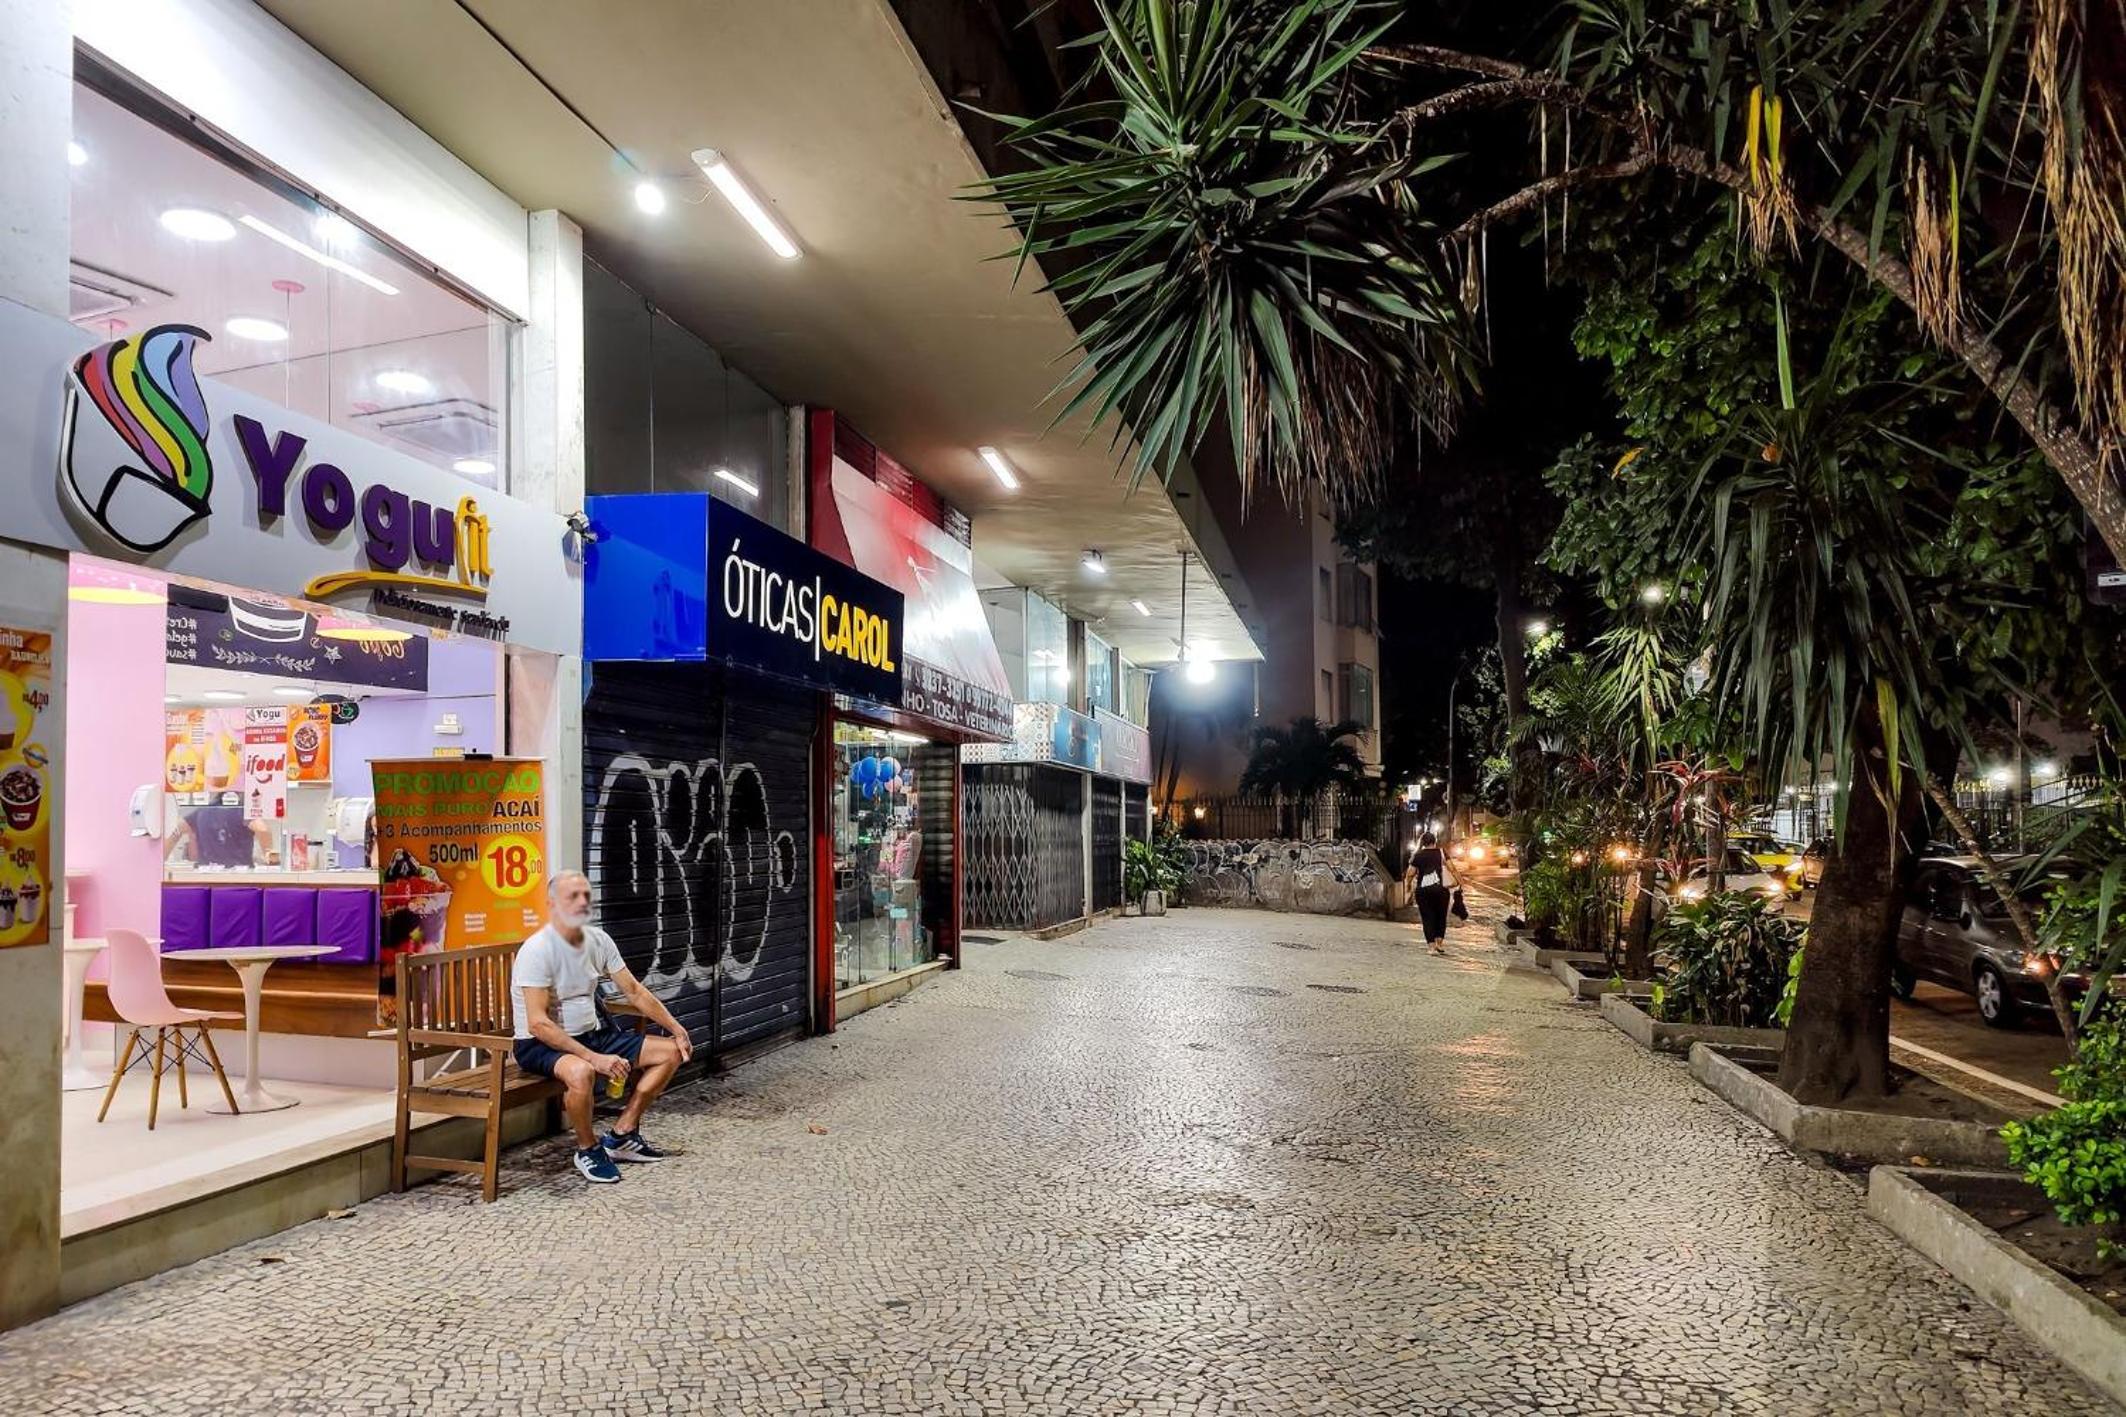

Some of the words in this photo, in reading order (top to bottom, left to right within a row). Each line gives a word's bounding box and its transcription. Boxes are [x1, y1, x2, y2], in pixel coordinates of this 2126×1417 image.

[724, 538, 814, 642] ÓTICAS
[821, 594, 895, 673] CAROL
[256, 709, 281, 721] Yogu
[932, 699, 959, 722] TOSA
[401, 820, 543, 839] Acompanhamentos
[429, 842, 479, 864] 500ml
